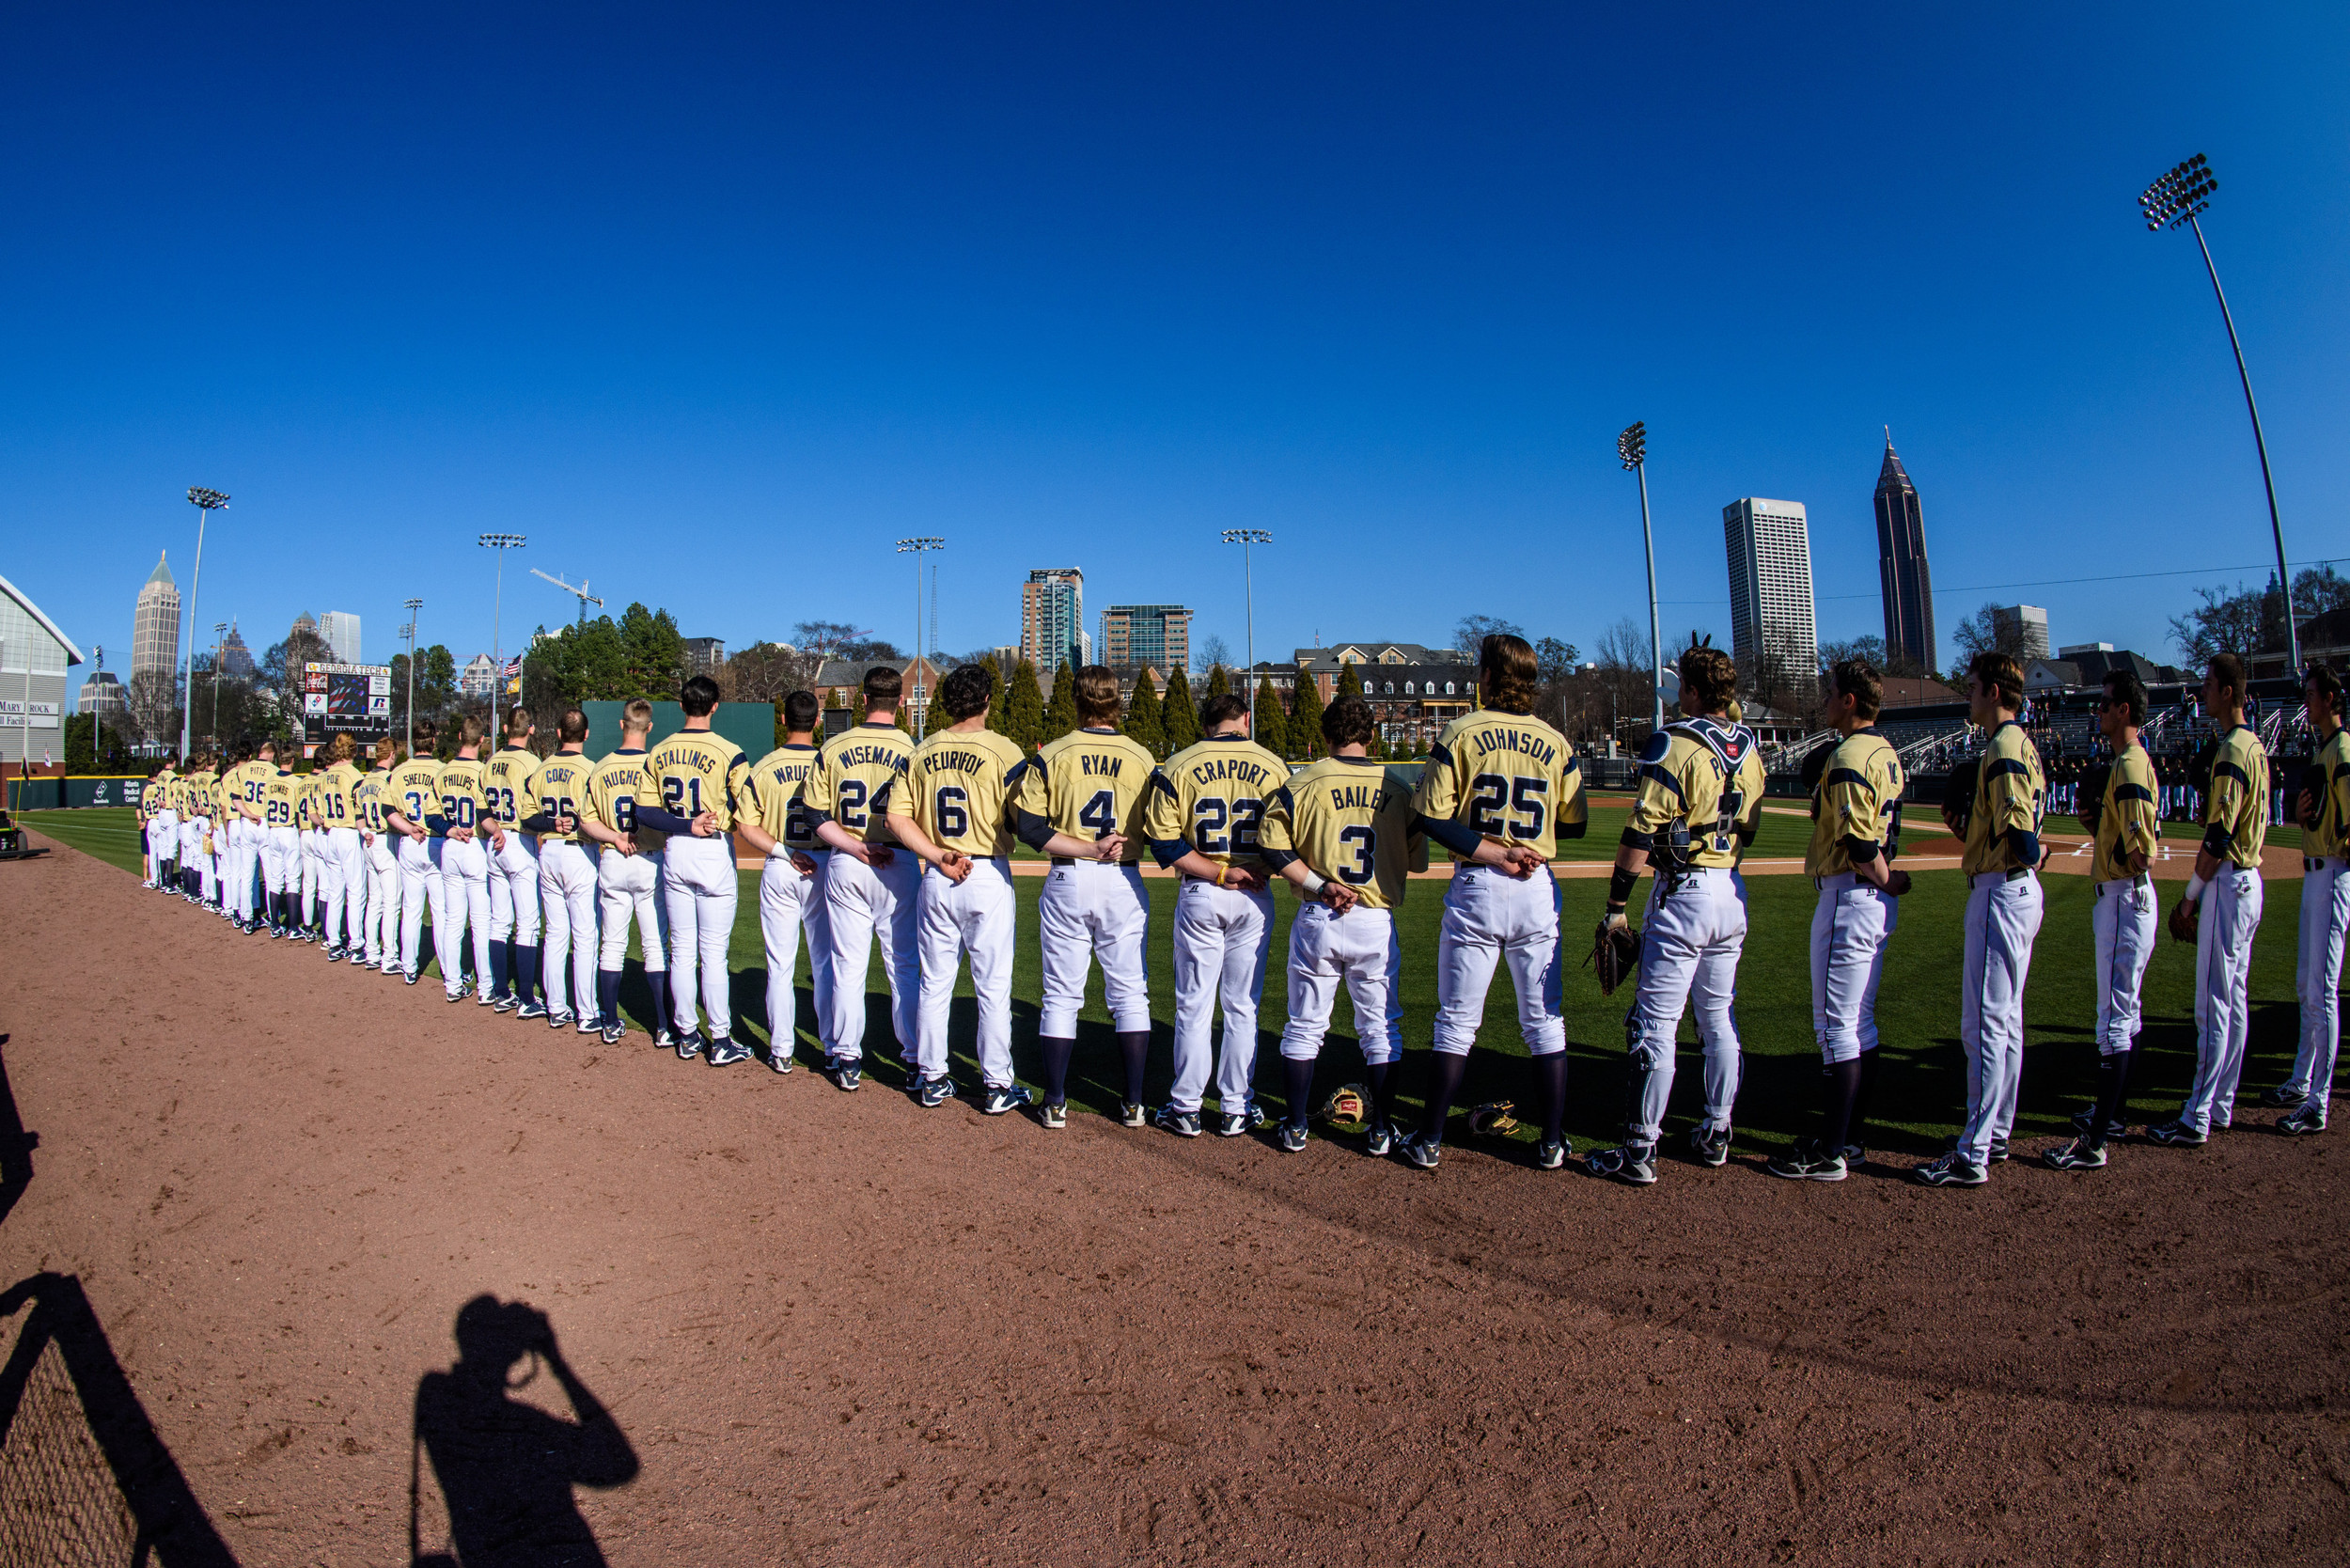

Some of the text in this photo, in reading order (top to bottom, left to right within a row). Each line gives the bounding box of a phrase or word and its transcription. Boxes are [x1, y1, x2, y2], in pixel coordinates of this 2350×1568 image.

[320, 664, 381, 675] GEORGIA TECH
[0, 700, 50, 713] MARY ROCK
[7, 715, 32, 726] Faciliy
[656, 749, 716, 775] STALLINGS
[838, 745, 903, 771] WISEMAN
[1472, 729, 1556, 767] JOHNSON
[250, 766, 267, 776] PITTS
[545, 768, 575, 785] GORST
[923, 751, 986, 776] PEURIFOY
[1081, 754, 1122, 778] RYAN
[1192, 759, 1270, 787] CRAPORT
[270, 784, 290, 796] COMBS
[443, 773, 475, 791] PHILLIPS
[145, 800, 160, 816] 42
[267, 799, 290, 823] 29
[325, 792, 345, 820] 16
[405, 791, 430, 823] 3
[442, 794, 475, 828] 20
[485, 786, 516, 822] 23
[663, 776, 705, 819] 21
[838, 778, 894, 828] 24
[1330, 786, 1393, 814] BAILEY
[1468, 772, 1549, 840] 25
[362, 802, 382, 829] 14
[540, 795, 580, 833] 26
[614, 794, 639, 834] 8
[936, 785, 968, 839] 6
[1078, 790, 1118, 841] 4
[1194, 796, 1266, 855] 22
[1337, 824, 1377, 885] 3
